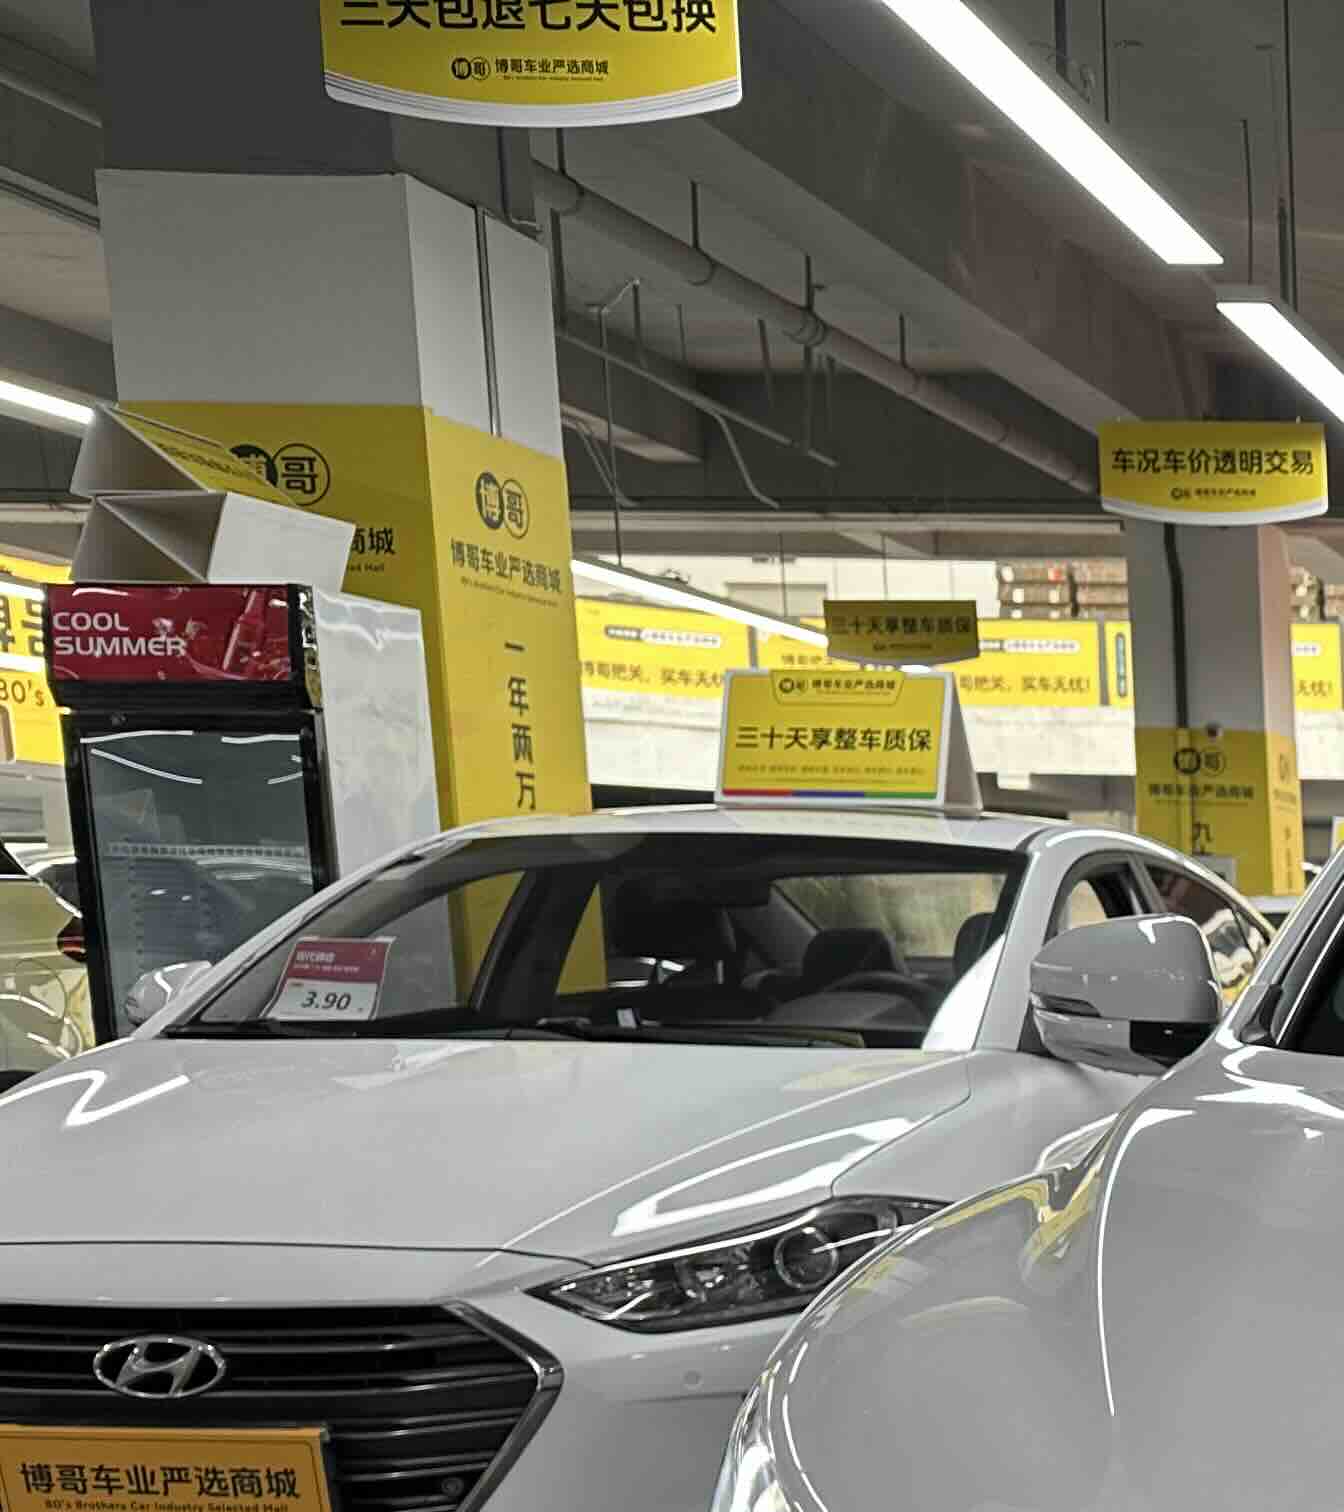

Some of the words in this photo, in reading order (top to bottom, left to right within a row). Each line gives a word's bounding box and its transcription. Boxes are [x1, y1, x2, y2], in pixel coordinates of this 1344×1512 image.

[1112, 448, 1314, 475] 车况车价透明交易
[450, 537, 562, 593] 博哥车业严选商城
[53, 612, 129, 631] COOL
[54, 636, 187, 656] SUMMER
[735, 726, 932, 752] 三十天享整车质保
[301, 991, 352, 1011] 3.90
[18, 1463, 301, 1499] 博哥车业严选商城
